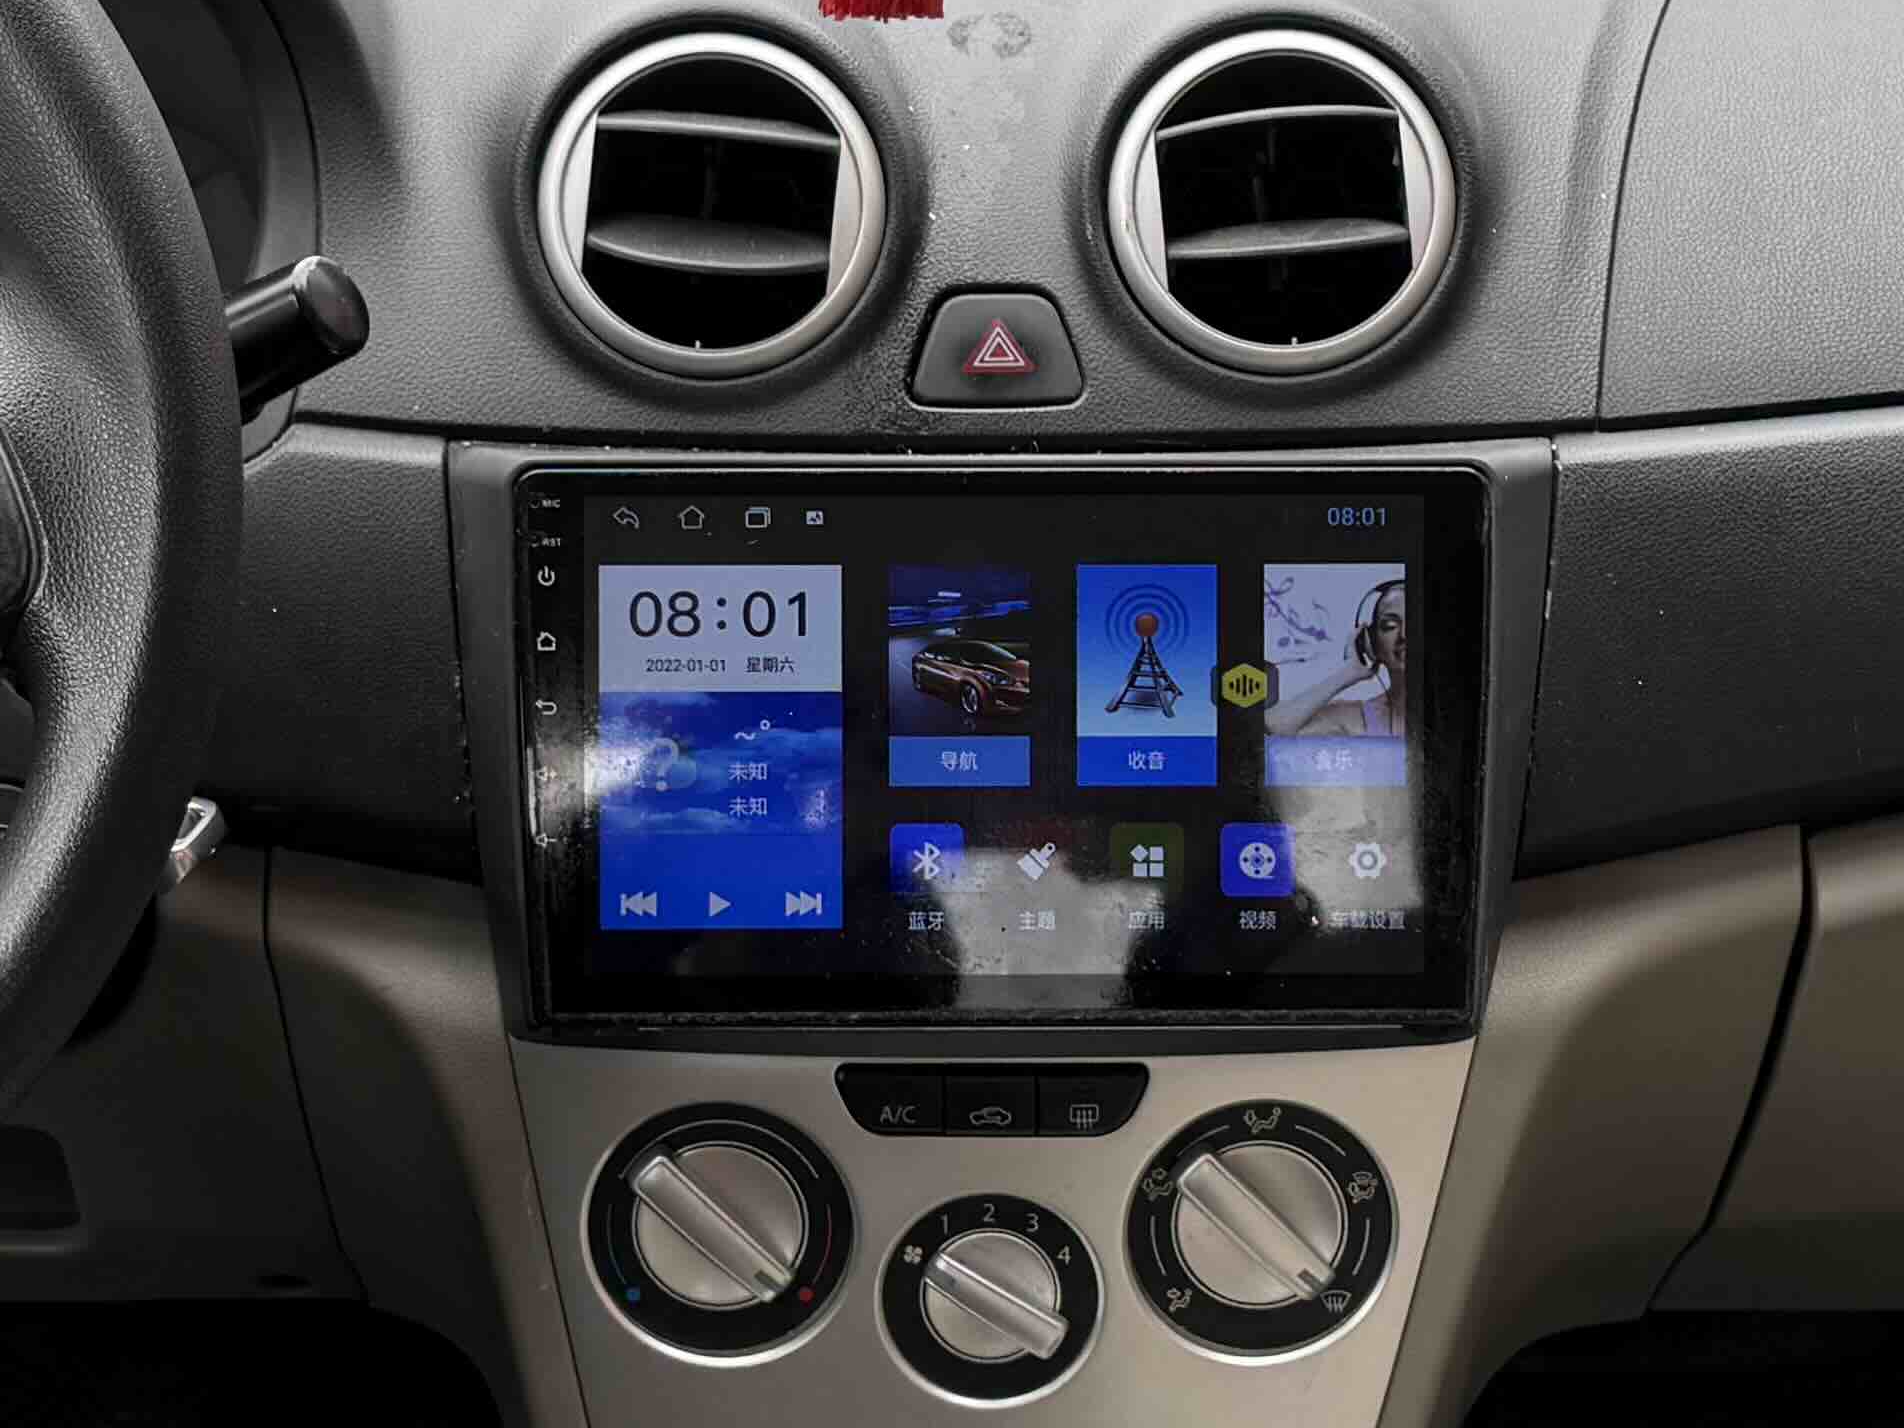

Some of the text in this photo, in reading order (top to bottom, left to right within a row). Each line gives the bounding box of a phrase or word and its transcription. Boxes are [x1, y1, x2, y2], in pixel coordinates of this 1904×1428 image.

[1327, 507, 1386, 526] 08:01
[629, 590, 808, 638] 08:01
[646, 656, 796, 674] 2022-01-01 星期六
[941, 751, 977, 771] 导航
[1128, 751, 1165, 771] 收音
[728, 763, 767, 782] 未知
[728, 797, 767, 816] 未知
[908, 911, 945, 931] 蓝牙
[1018, 911, 1056, 931] 主题
[1128, 911, 1165, 931] 应用
[1239, 911, 1277, 931] 视频
[880, 1105, 916, 1124] A/C
[941, 1204, 1072, 1264] 1 2 3 4
